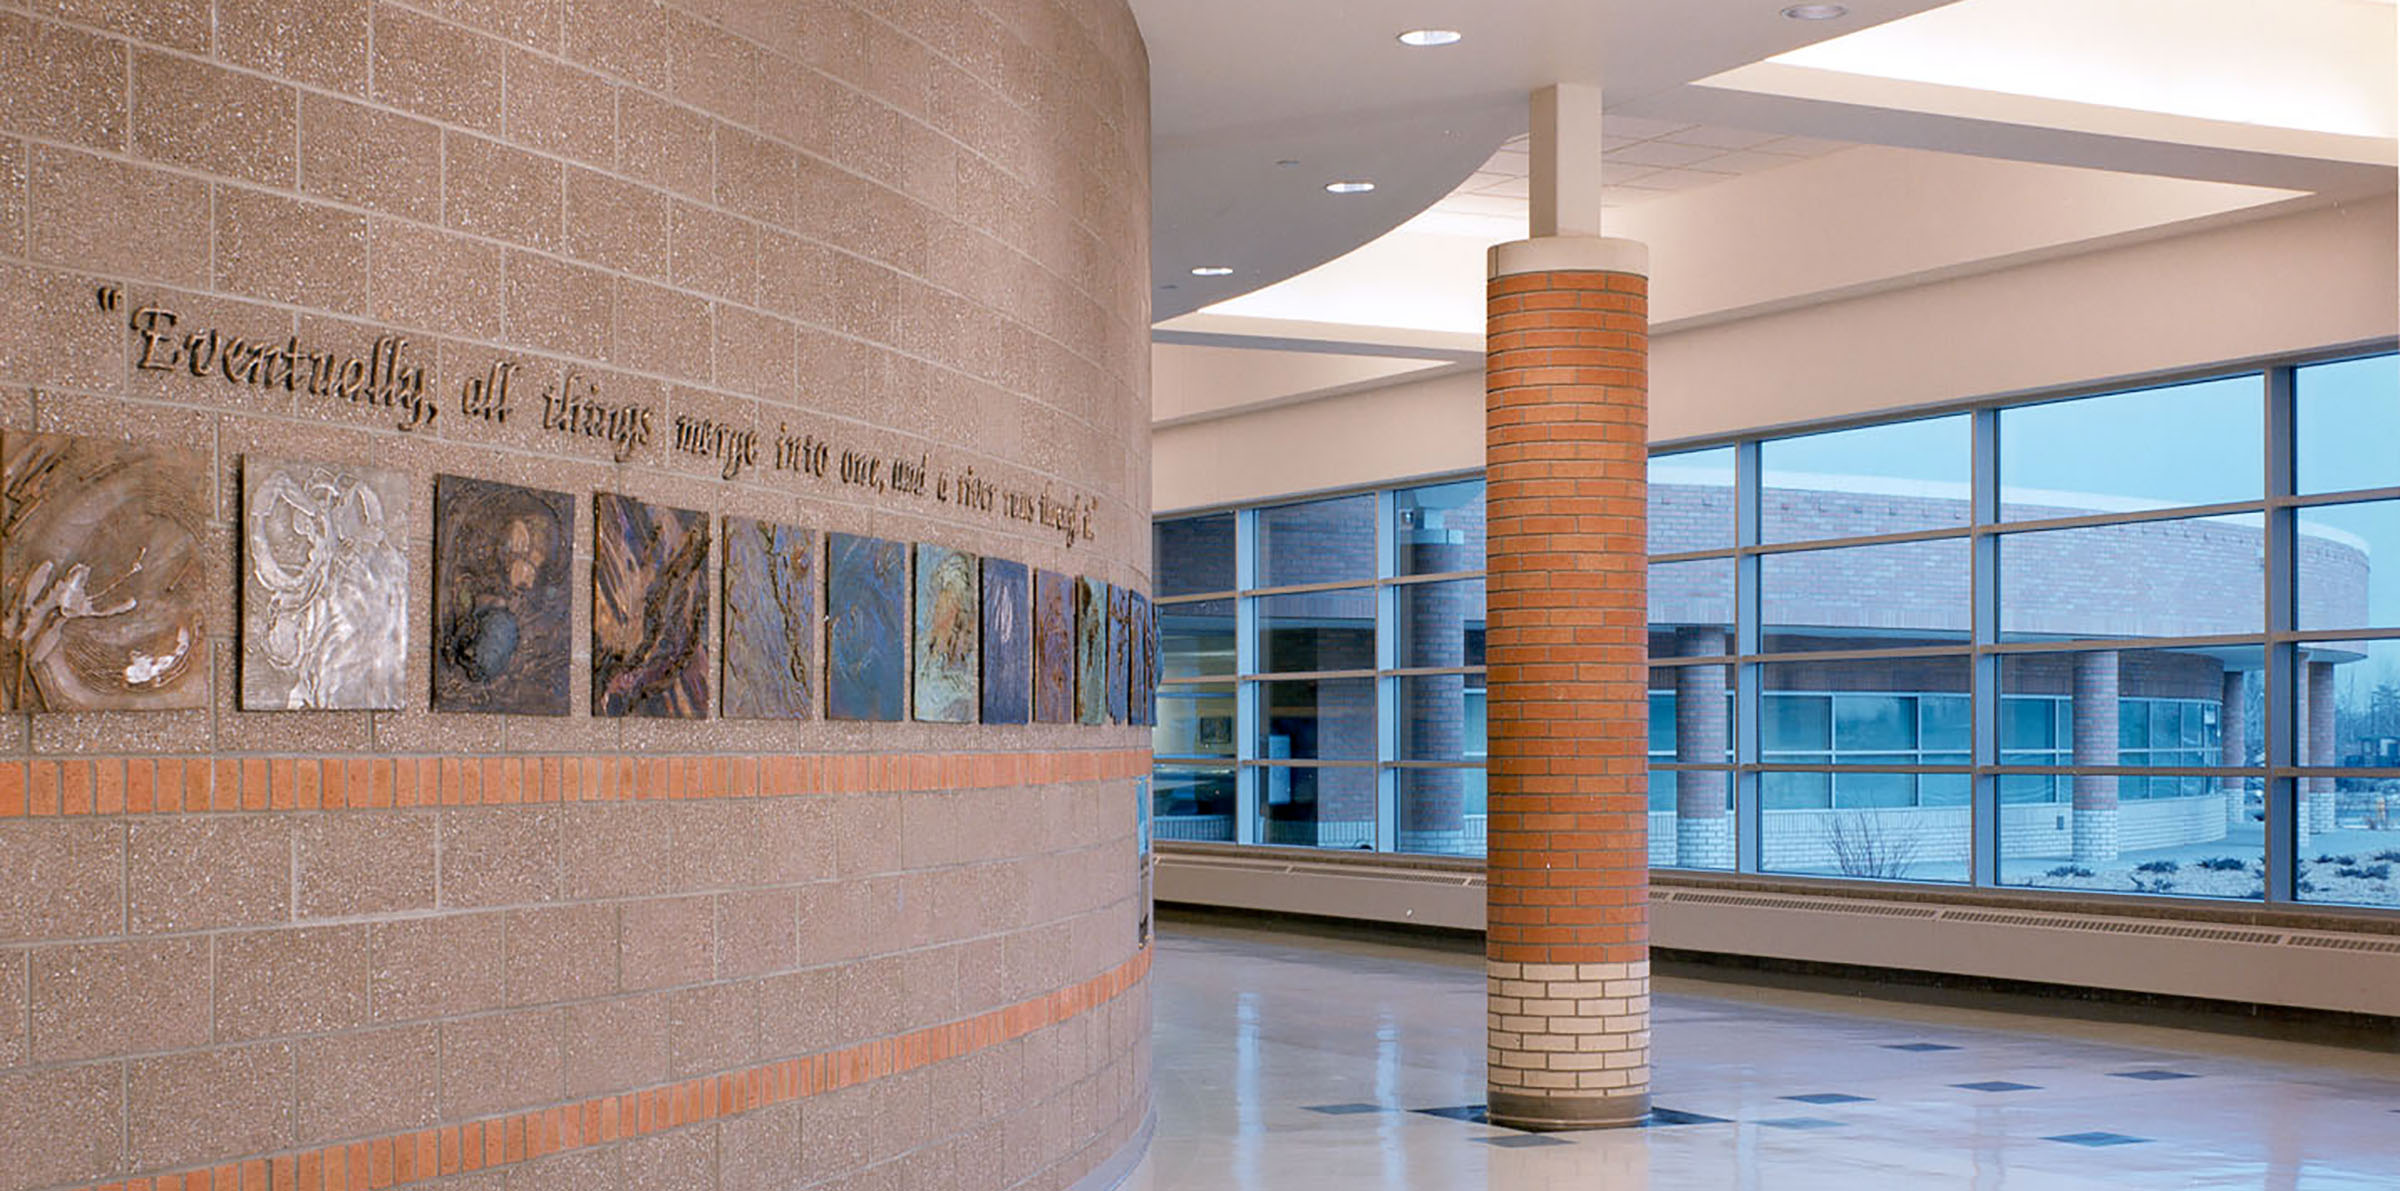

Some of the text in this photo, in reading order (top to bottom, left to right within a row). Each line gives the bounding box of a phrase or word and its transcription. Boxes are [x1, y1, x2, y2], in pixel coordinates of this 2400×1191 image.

[462, 361, 519, 423] all
[542, 370, 652, 463] things
[676, 414, 758, 480] merge
[776, 422, 829, 477] into
[840, 448, 886, 494] one,
[891, 450, 930, 496] and
[937, 470, 948, 502] a
[956, 465, 998, 512] river
[1002, 490, 1035, 522] runs
